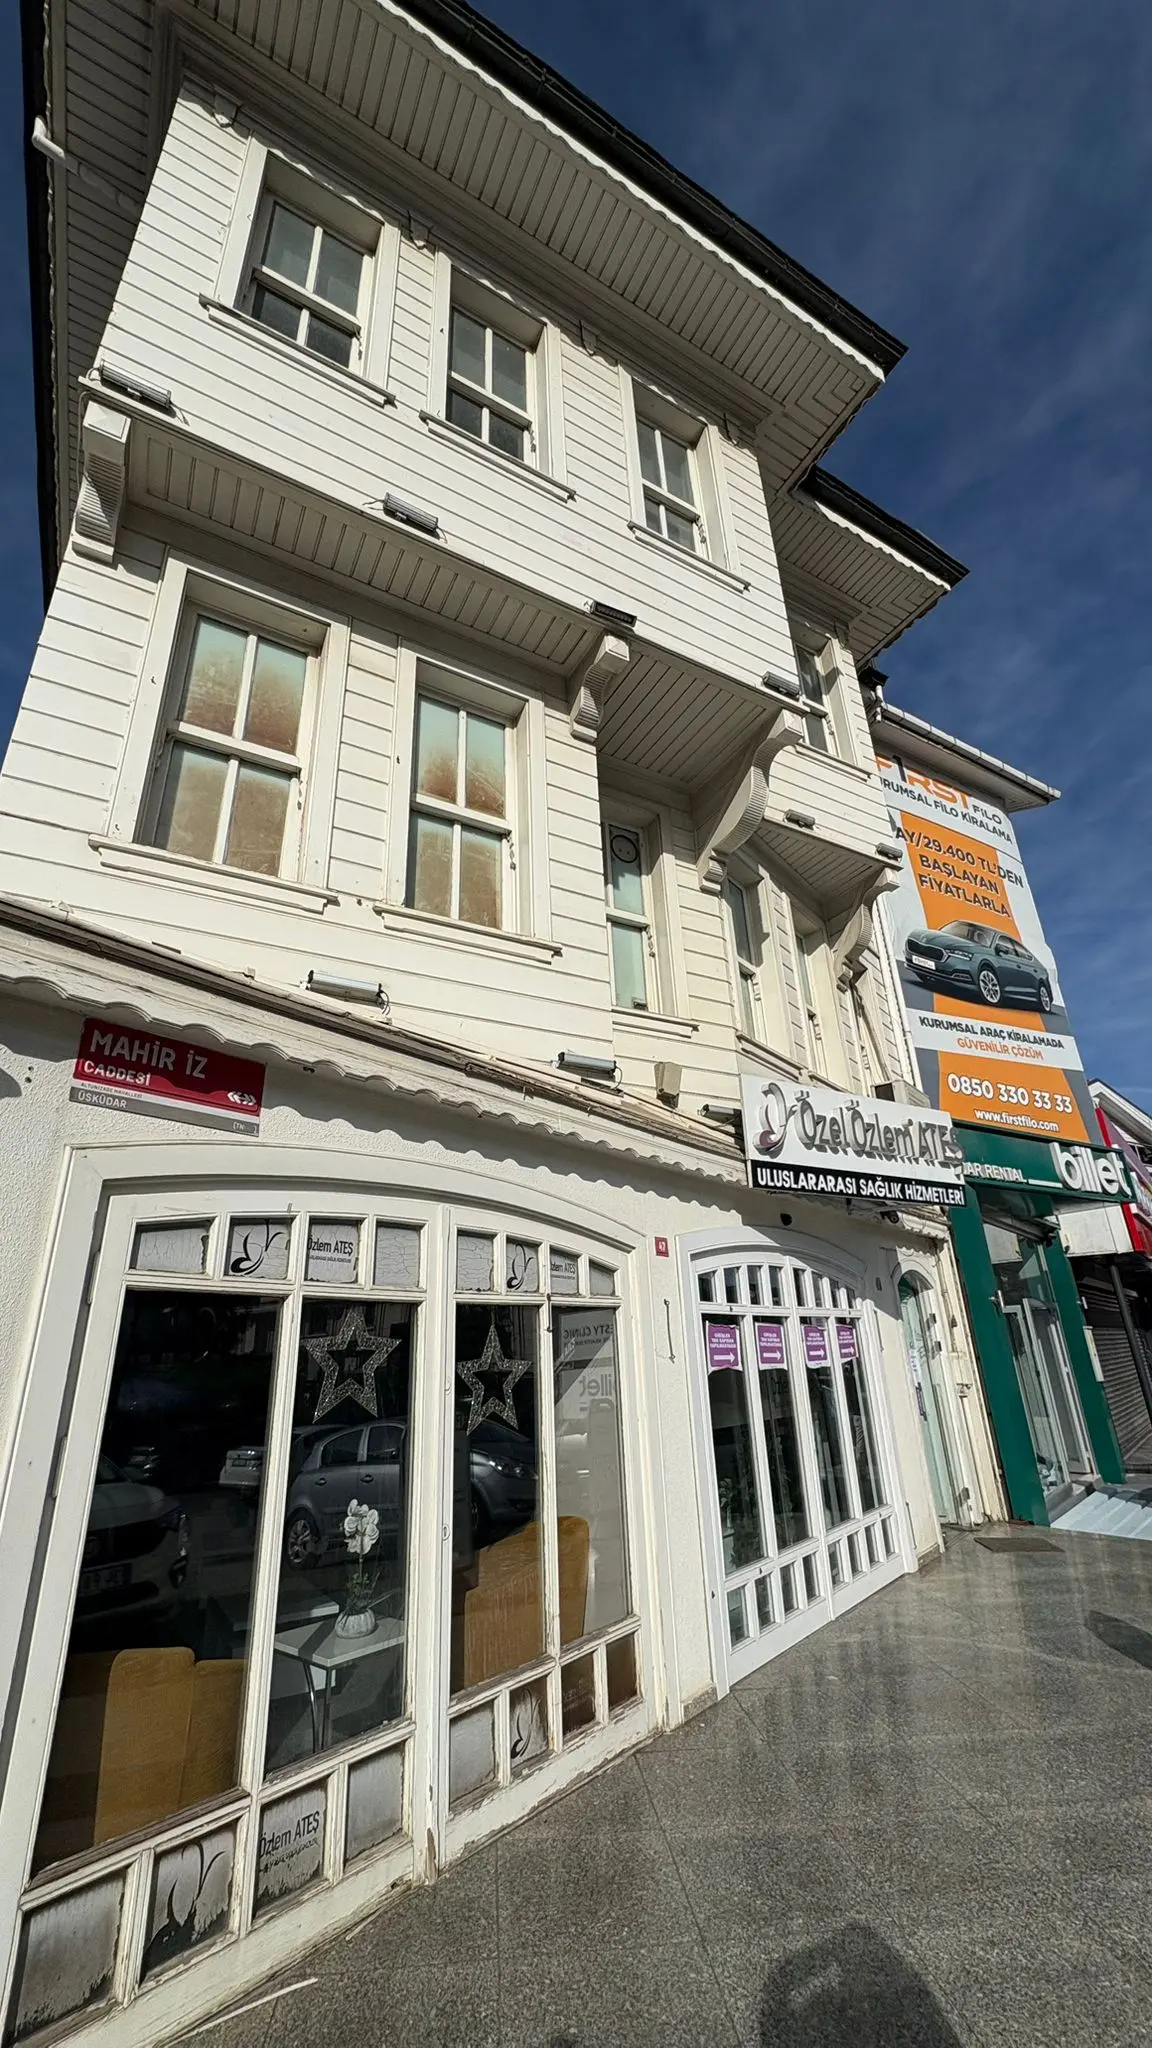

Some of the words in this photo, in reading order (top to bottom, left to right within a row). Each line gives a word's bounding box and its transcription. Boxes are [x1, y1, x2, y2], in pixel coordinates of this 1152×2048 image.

[934, 800, 959, 818] FİLO
[961, 810, 1013, 844] KİRALAMA
[918, 854, 999, 895] BAŞLAYAN
[978, 857, 1024, 888] TL'DEN
[918, 873, 1011, 918] FİYATLARLA
[919, 1016, 978, 1035] KURUMSAL
[980, 1026, 1005, 1040] ARAÇ
[1006, 1029, 1065, 1049] KİRALAMADA
[957, 1036, 1009, 1055] GÜVENİLİR
[1011, 1045, 1044, 1060] ÇÖZÜM
[90, 1029, 176, 1071] MAHİR
[186, 1049, 208, 1079] İZ
[84, 1060, 151, 1086] CADDESİ
[78, 1090, 127, 1109] ÜSKÜDAR
[947, 1073, 994, 1100] 0850
[997, 1083, 1029, 1106] 330
[1032, 1090, 1052, 1110] 33
[1054, 1094, 1073, 1113] 33
[796, 1090, 850, 1150] Özel
[847, 1099, 916, 1158] Özlem
[974, 1109, 1060, 1132] www.firstfilo.com
[757, 1167, 857, 1195] ULUSLARARASI
[859, 1176, 903, 1199] SAĞLIK
[905, 1181, 965, 1205] HİZMETLERİ
[984, 1164, 1027, 1183] RENTAL
[1049, 1142, 1132, 1198] billet
[333, 1240, 354, 1257] ATEŞ
[293, 1811, 320, 1842] ATEŞ
